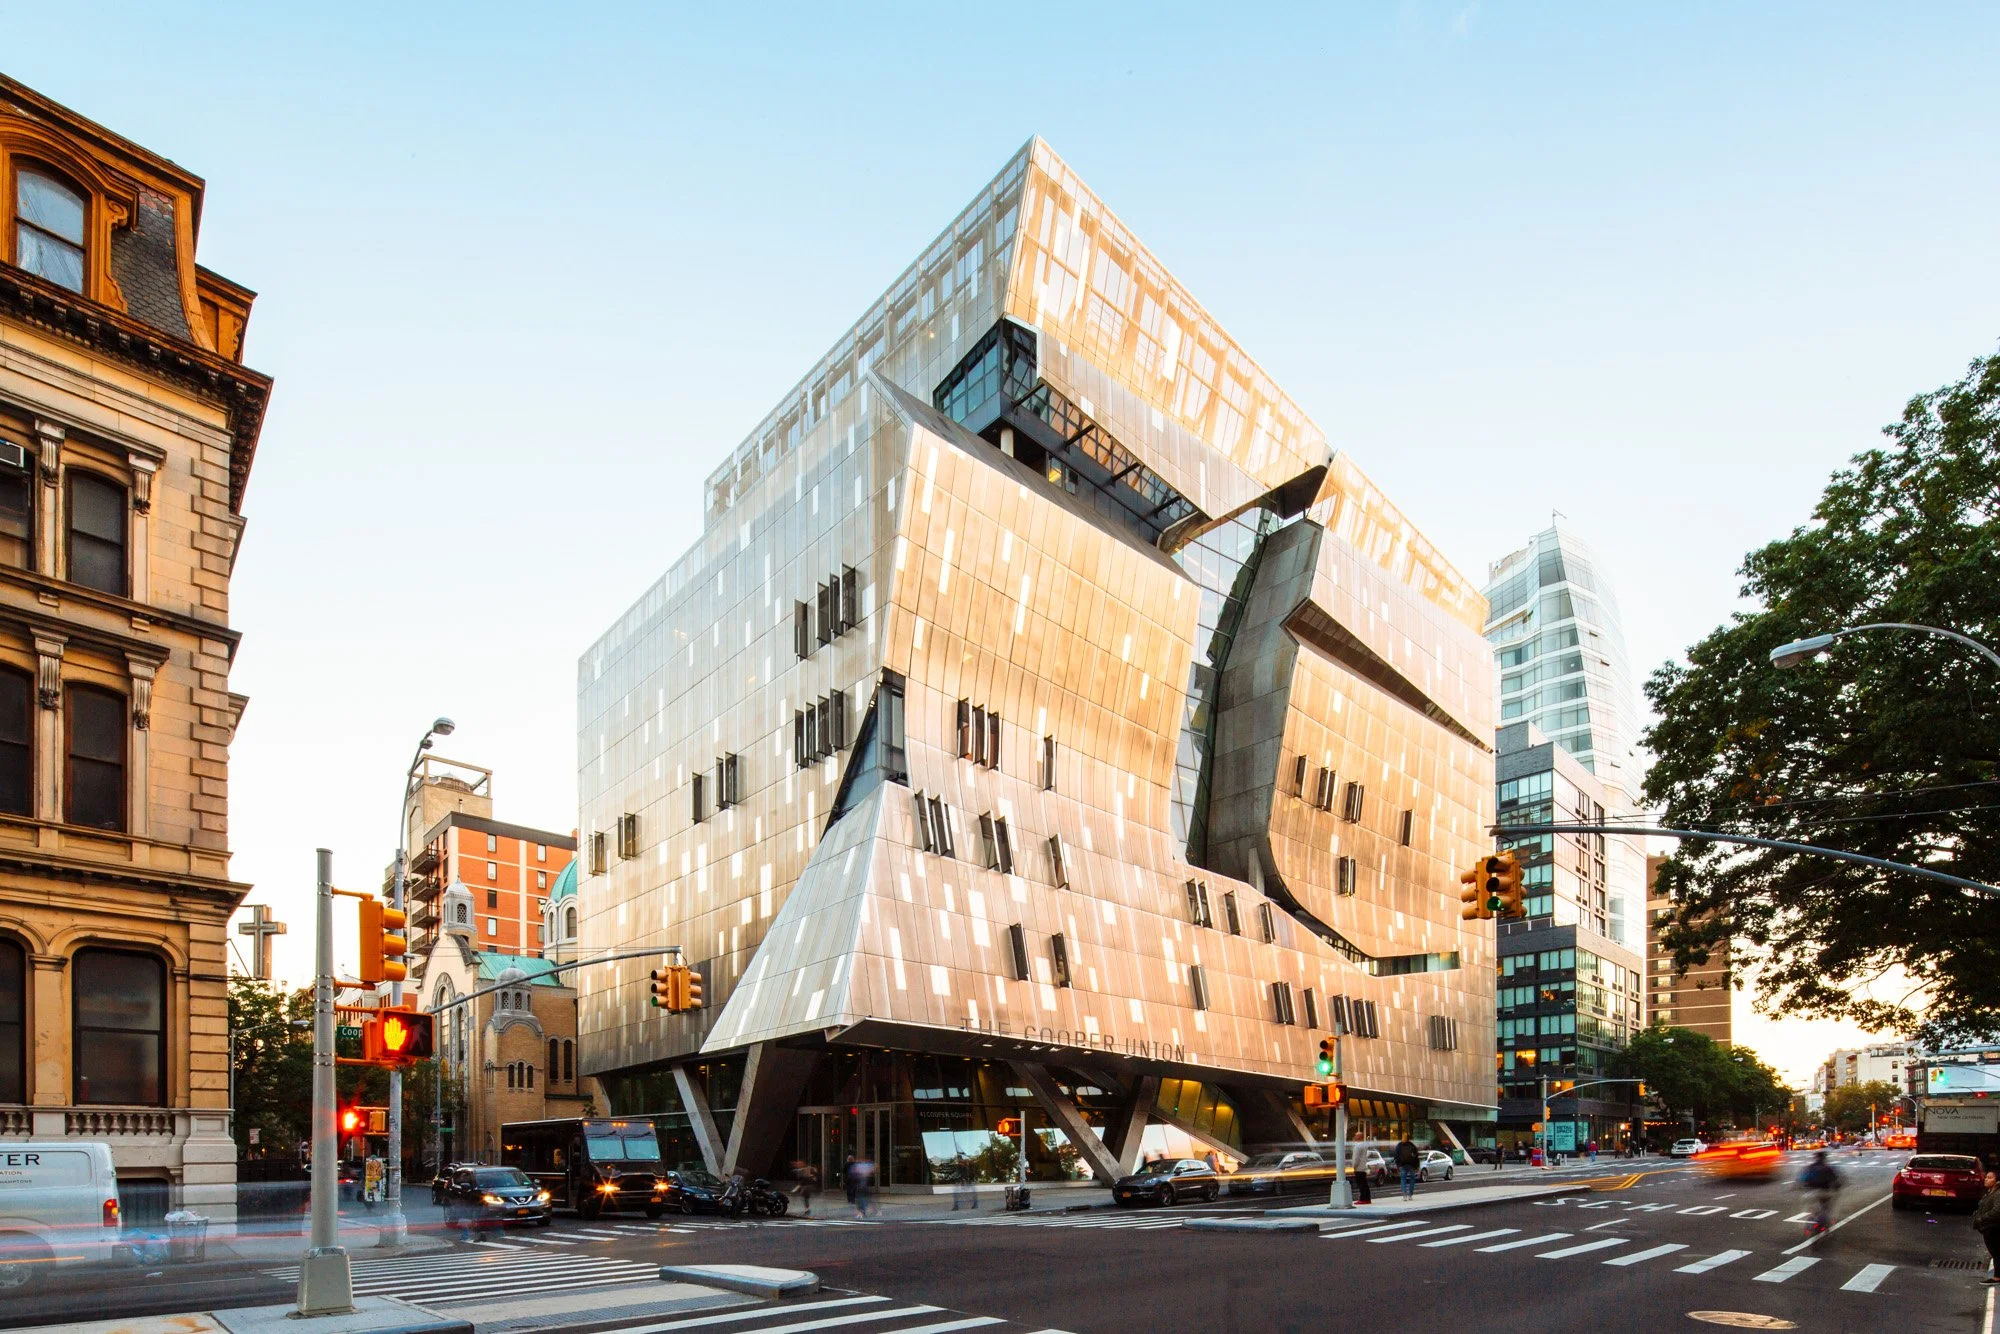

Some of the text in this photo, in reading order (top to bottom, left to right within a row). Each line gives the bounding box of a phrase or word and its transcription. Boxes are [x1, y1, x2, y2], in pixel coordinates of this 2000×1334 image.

[961, 1017, 1185, 1063] THE COOPER UNION
[0, 1153, 40, 1166] ER
[1533, 1198, 1817, 1224] SCHOOL
